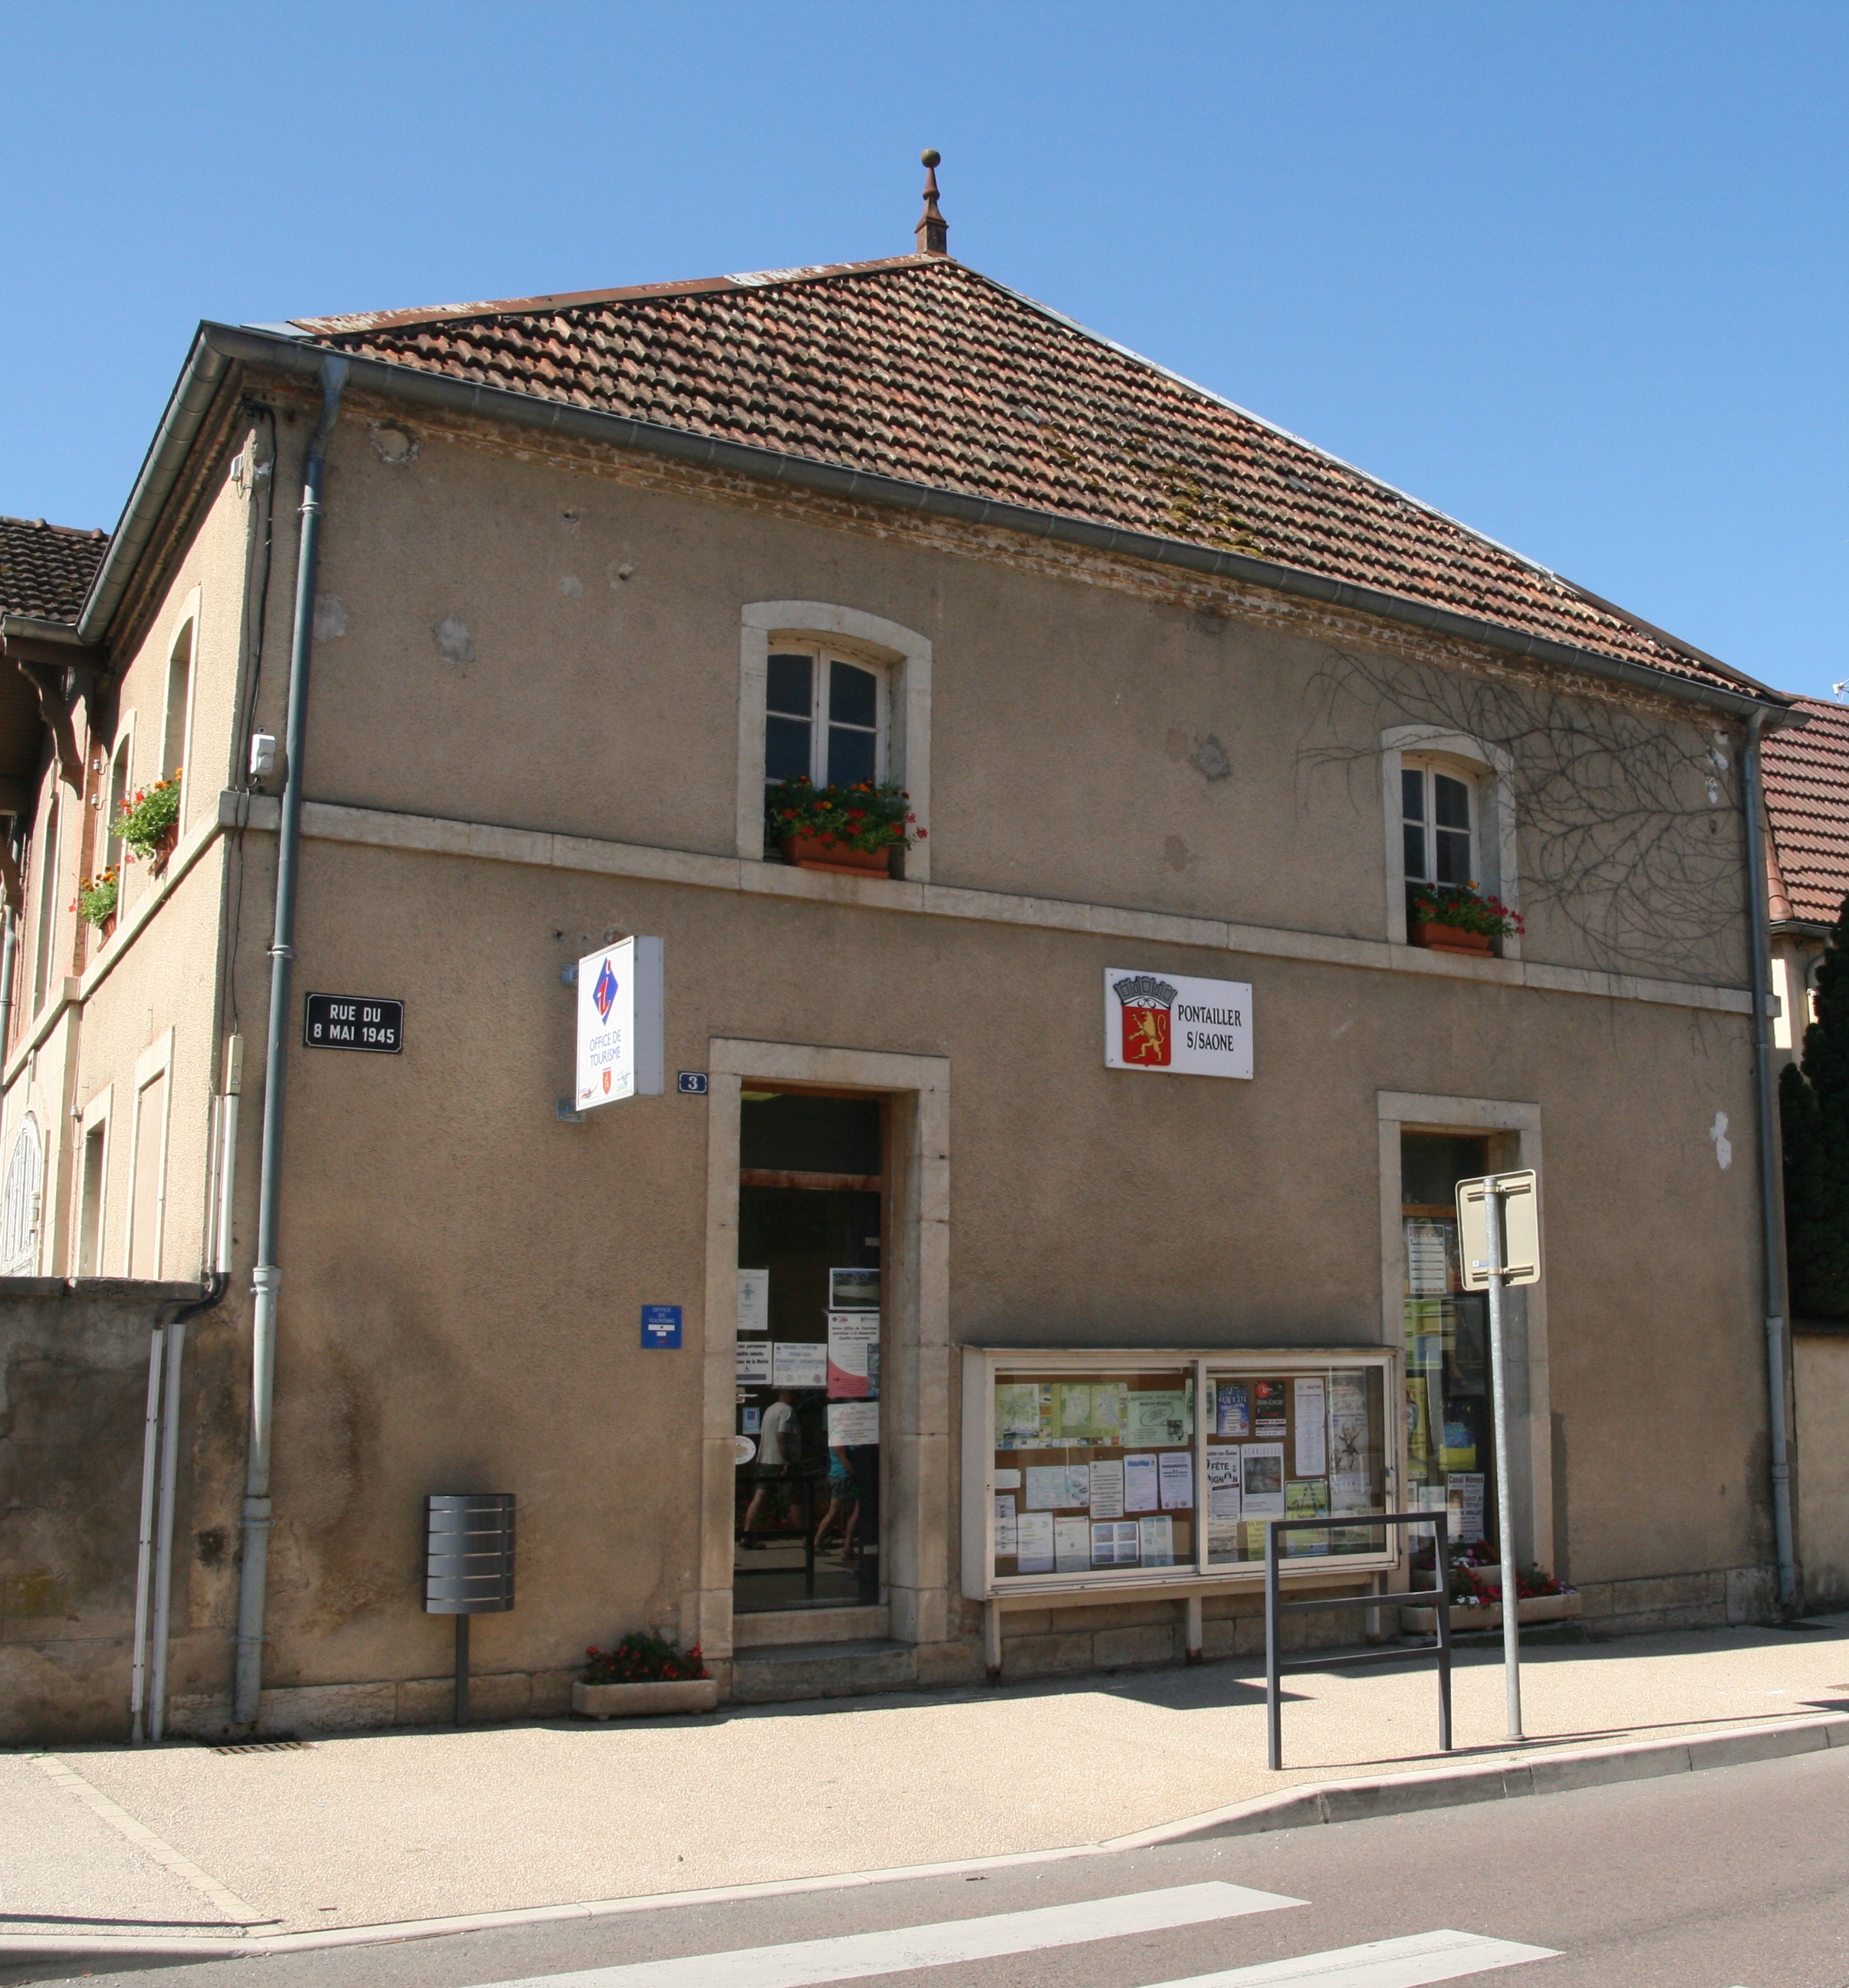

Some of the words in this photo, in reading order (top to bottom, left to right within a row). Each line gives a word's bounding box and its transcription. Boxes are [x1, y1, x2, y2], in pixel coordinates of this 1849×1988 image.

[330, 1005, 356, 1021] RUE
[364, 1007, 381, 1022] DU
[1177, 1004, 1242, 1026] PONTAILLER
[314, 1023, 322, 1038] 8
[330, 1025, 354, 1040] MAI
[362, 1028, 394, 1043] 1945
[590, 1032, 611, 1052] OFFICE
[613, 1029, 621, 1044] DE
[1186, 1031, 1234, 1052] S/SAONE
[590, 1045, 621, 1068] TOURISME
[688, 1075, 699, 1090] 3
